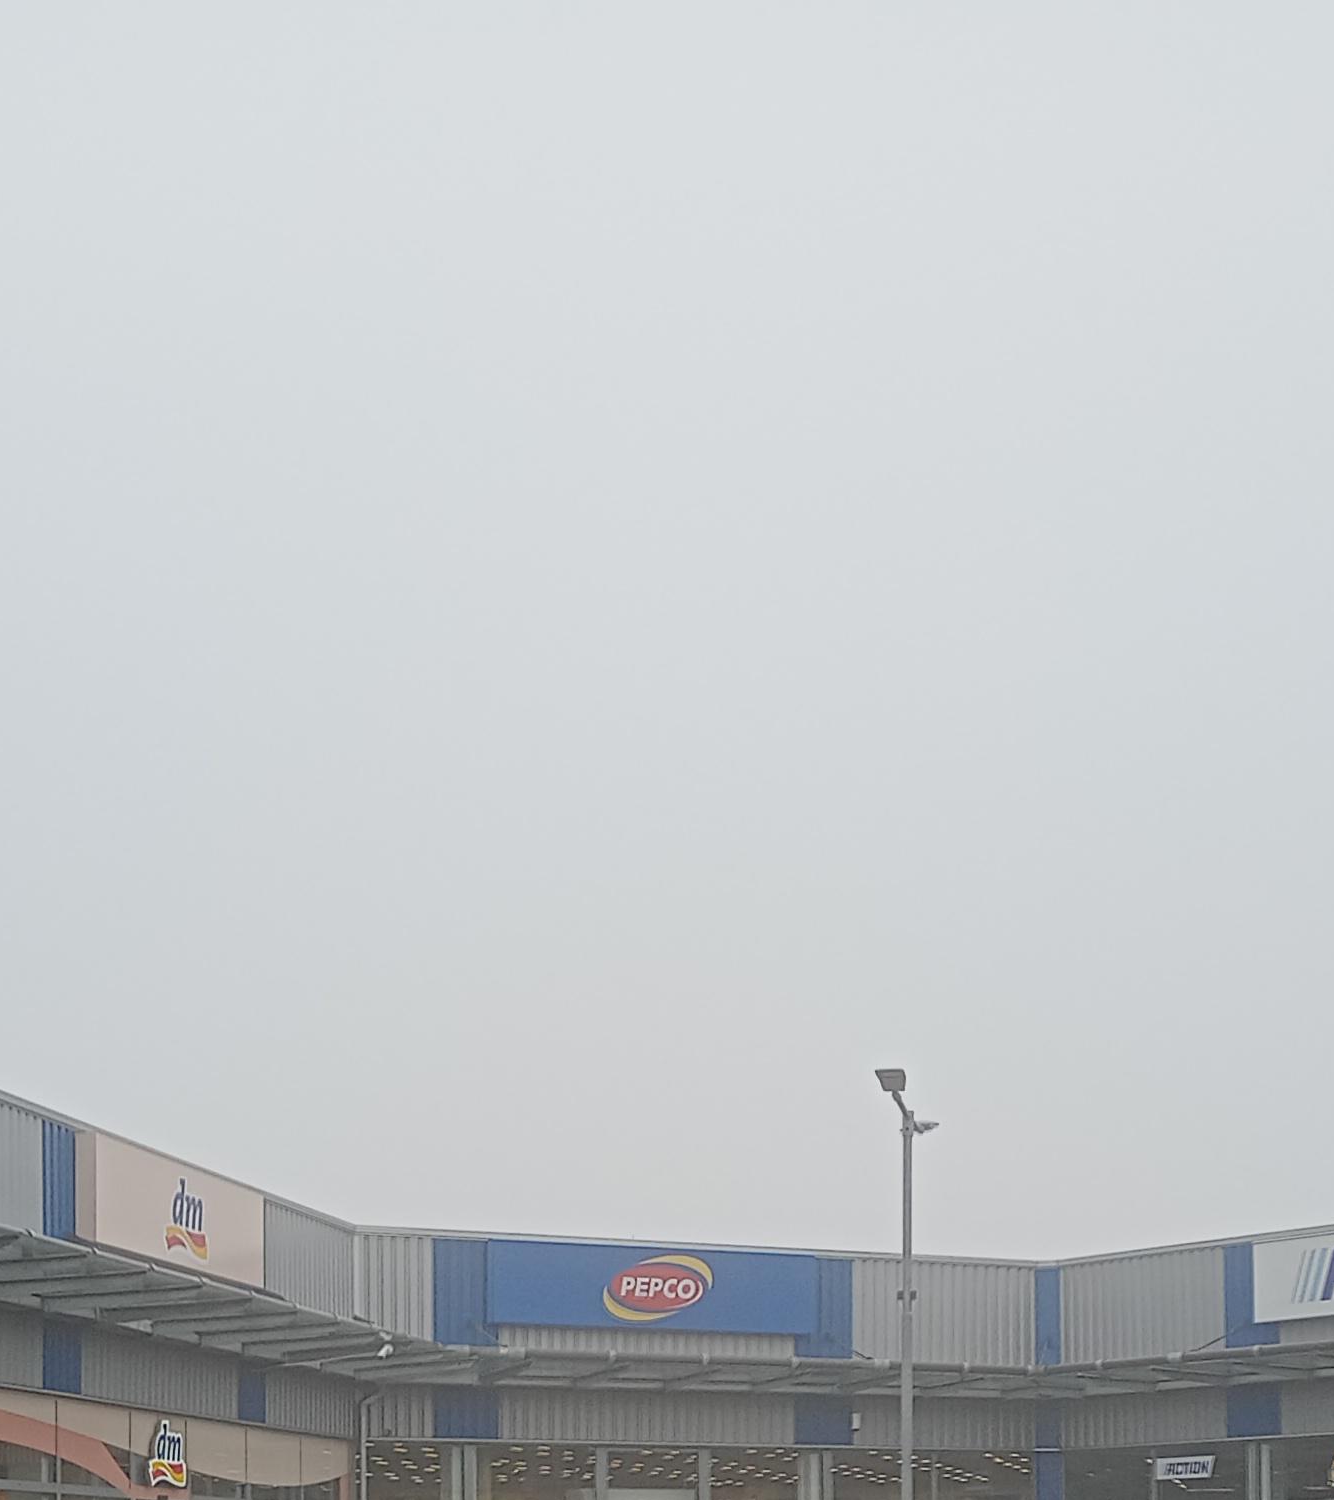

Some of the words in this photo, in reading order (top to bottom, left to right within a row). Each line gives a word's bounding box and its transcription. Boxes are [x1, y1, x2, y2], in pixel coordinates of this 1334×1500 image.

[172, 1177, 203, 1232] dm
[619, 1276, 697, 1300] PEPCO
[157, 1423, 181, 1462] dm
[1164, 1460, 1210, 1476] ACTION
